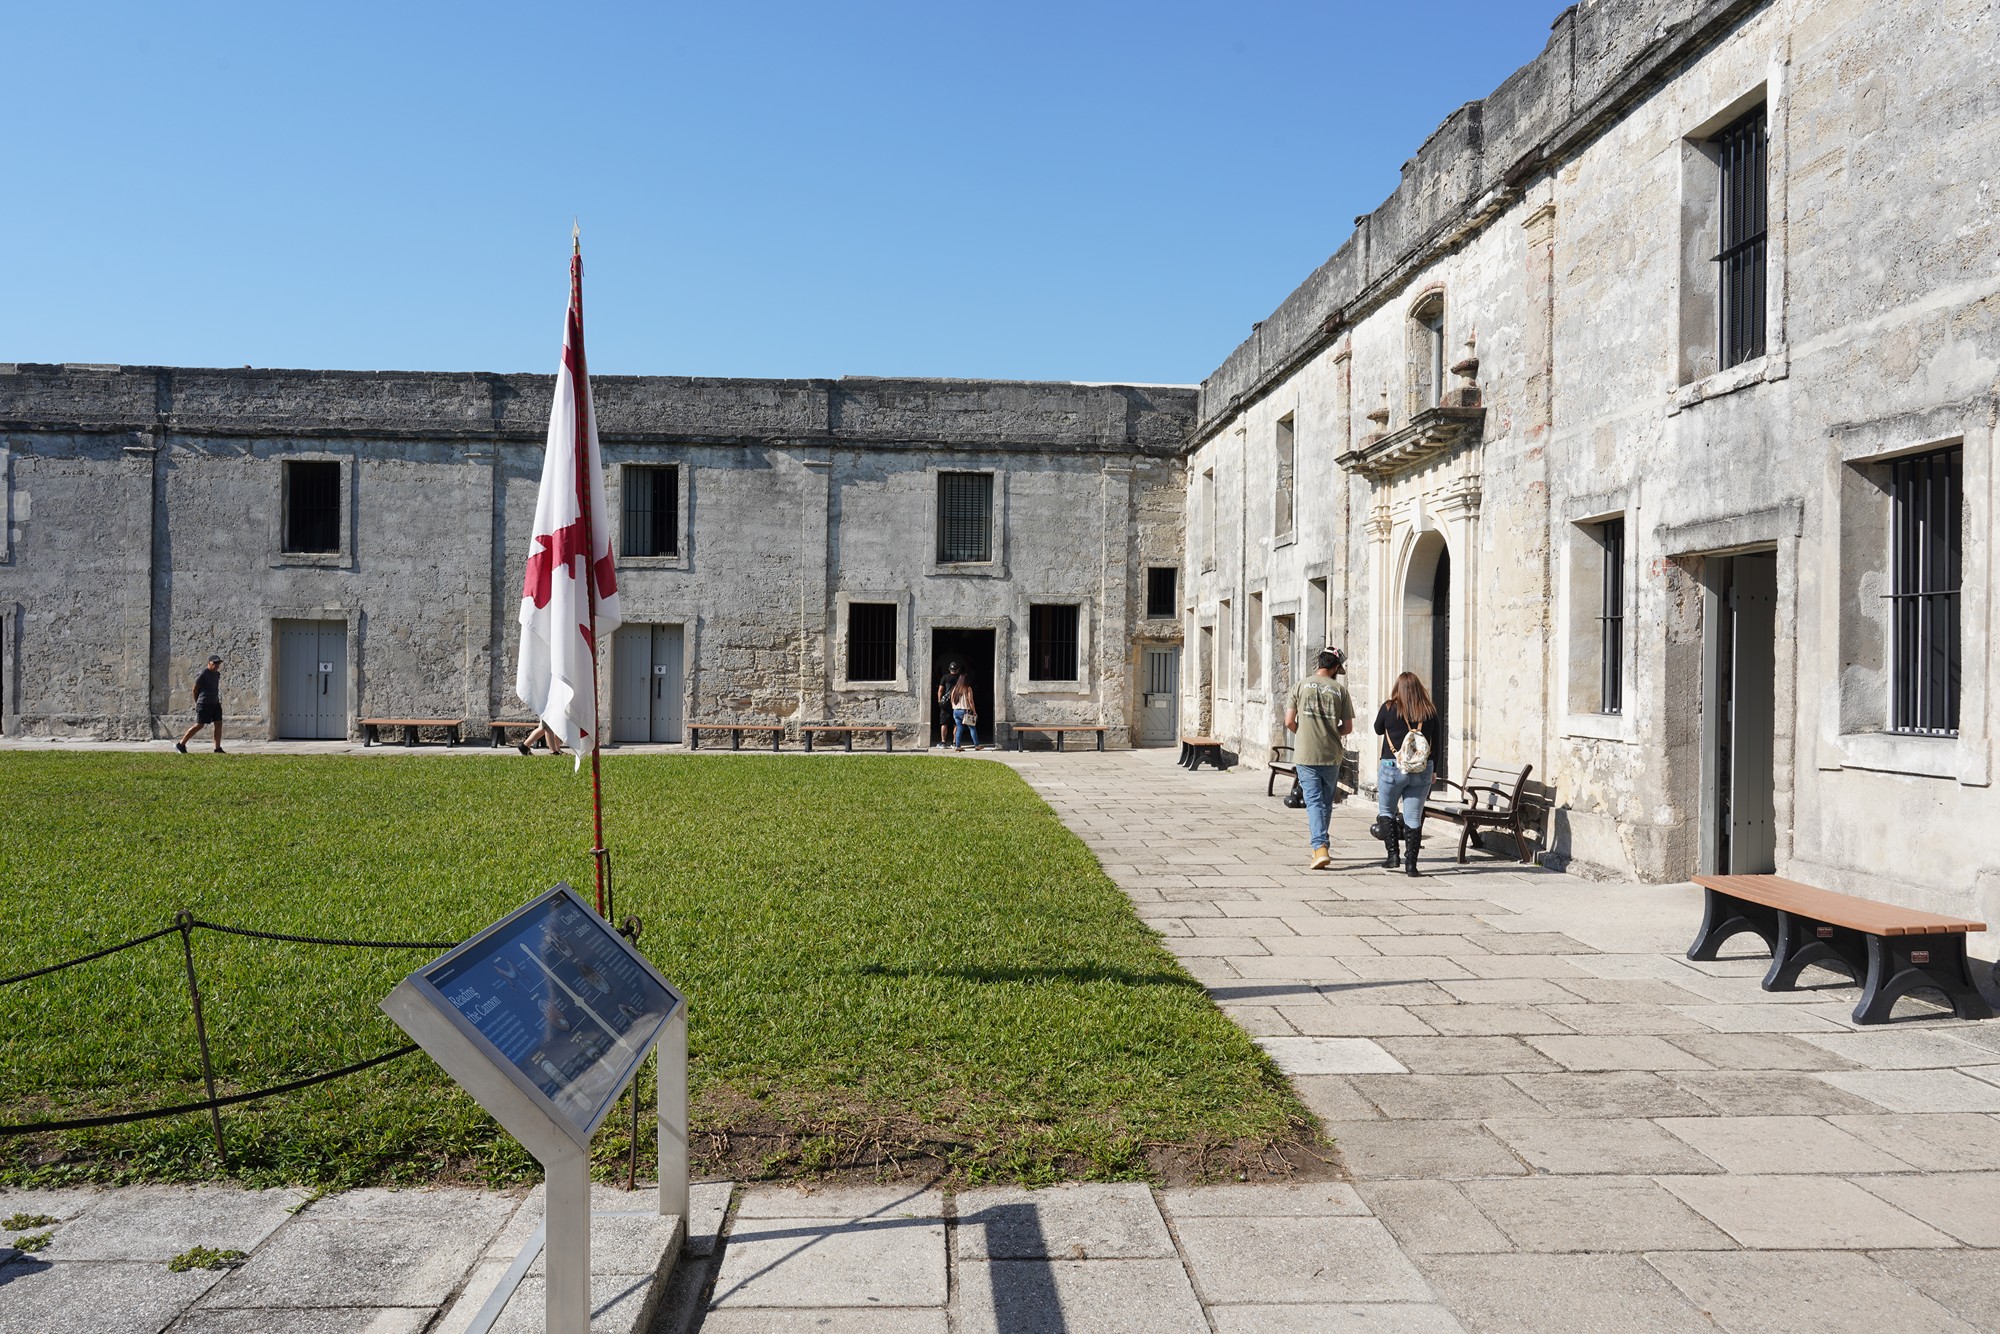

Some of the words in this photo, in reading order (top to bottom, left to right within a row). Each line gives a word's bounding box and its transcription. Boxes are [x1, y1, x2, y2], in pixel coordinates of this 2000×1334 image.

[448, 986, 480, 1008] Reading
[466, 1011, 482, 1024] the
[475, 996, 502, 1016] Cannon
